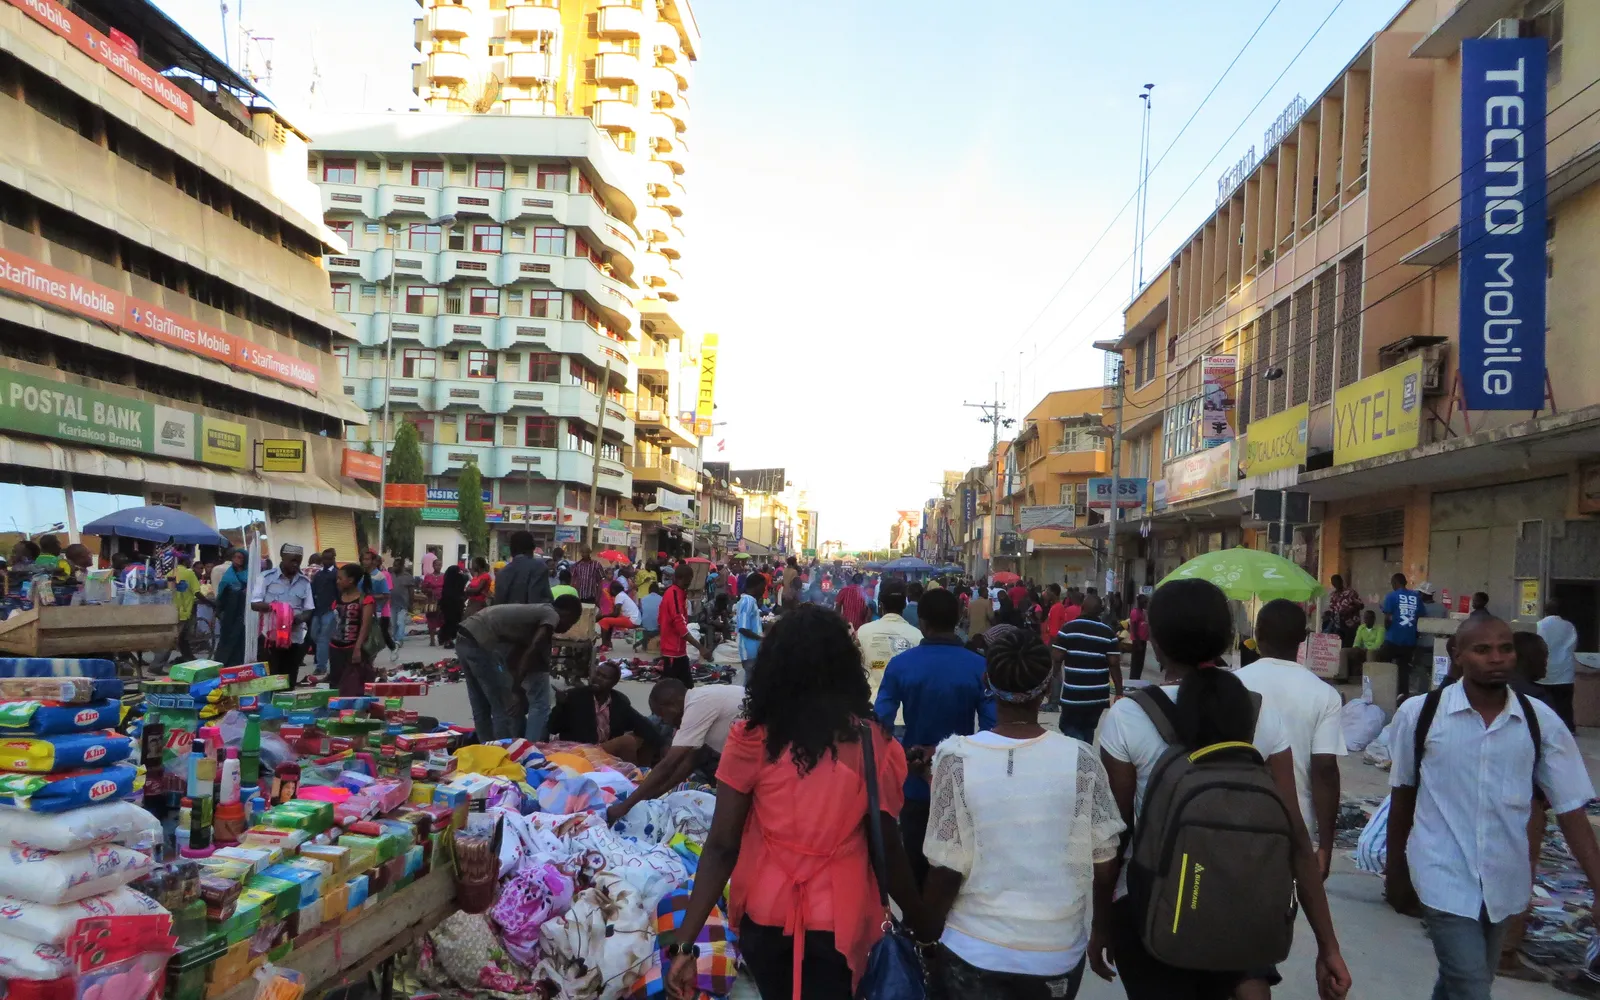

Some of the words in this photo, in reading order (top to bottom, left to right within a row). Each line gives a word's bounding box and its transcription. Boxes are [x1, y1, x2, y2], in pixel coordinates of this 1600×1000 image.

[25, 0, 71, 33] Mobile
[99, 40, 153, 90] StarTimes
[154, 77, 188, 113] Mobile
[0, 256, 67, 299] StarTimes
[69, 283, 115, 315] Mobile
[145, 310, 196, 343] StarTimes
[197, 330, 231, 355] Mobile
[1483, 253, 1522, 395] Mobile
[251, 349, 290, 376] StarTimes
[290, 363, 316, 384] Mobile
[699, 354, 715, 408] YXTEL
[10, 382, 88, 422] POSTAL
[93, 401, 142, 433] BANK
[1336, 388, 1396, 450] YXTEL
[58, 422, 106, 441] Kariakoo
[108, 432, 142, 448] Branch
[76, 711, 99, 724] Klin
[85, 748, 106, 760] Klin
[90, 783, 117, 800] Klin
